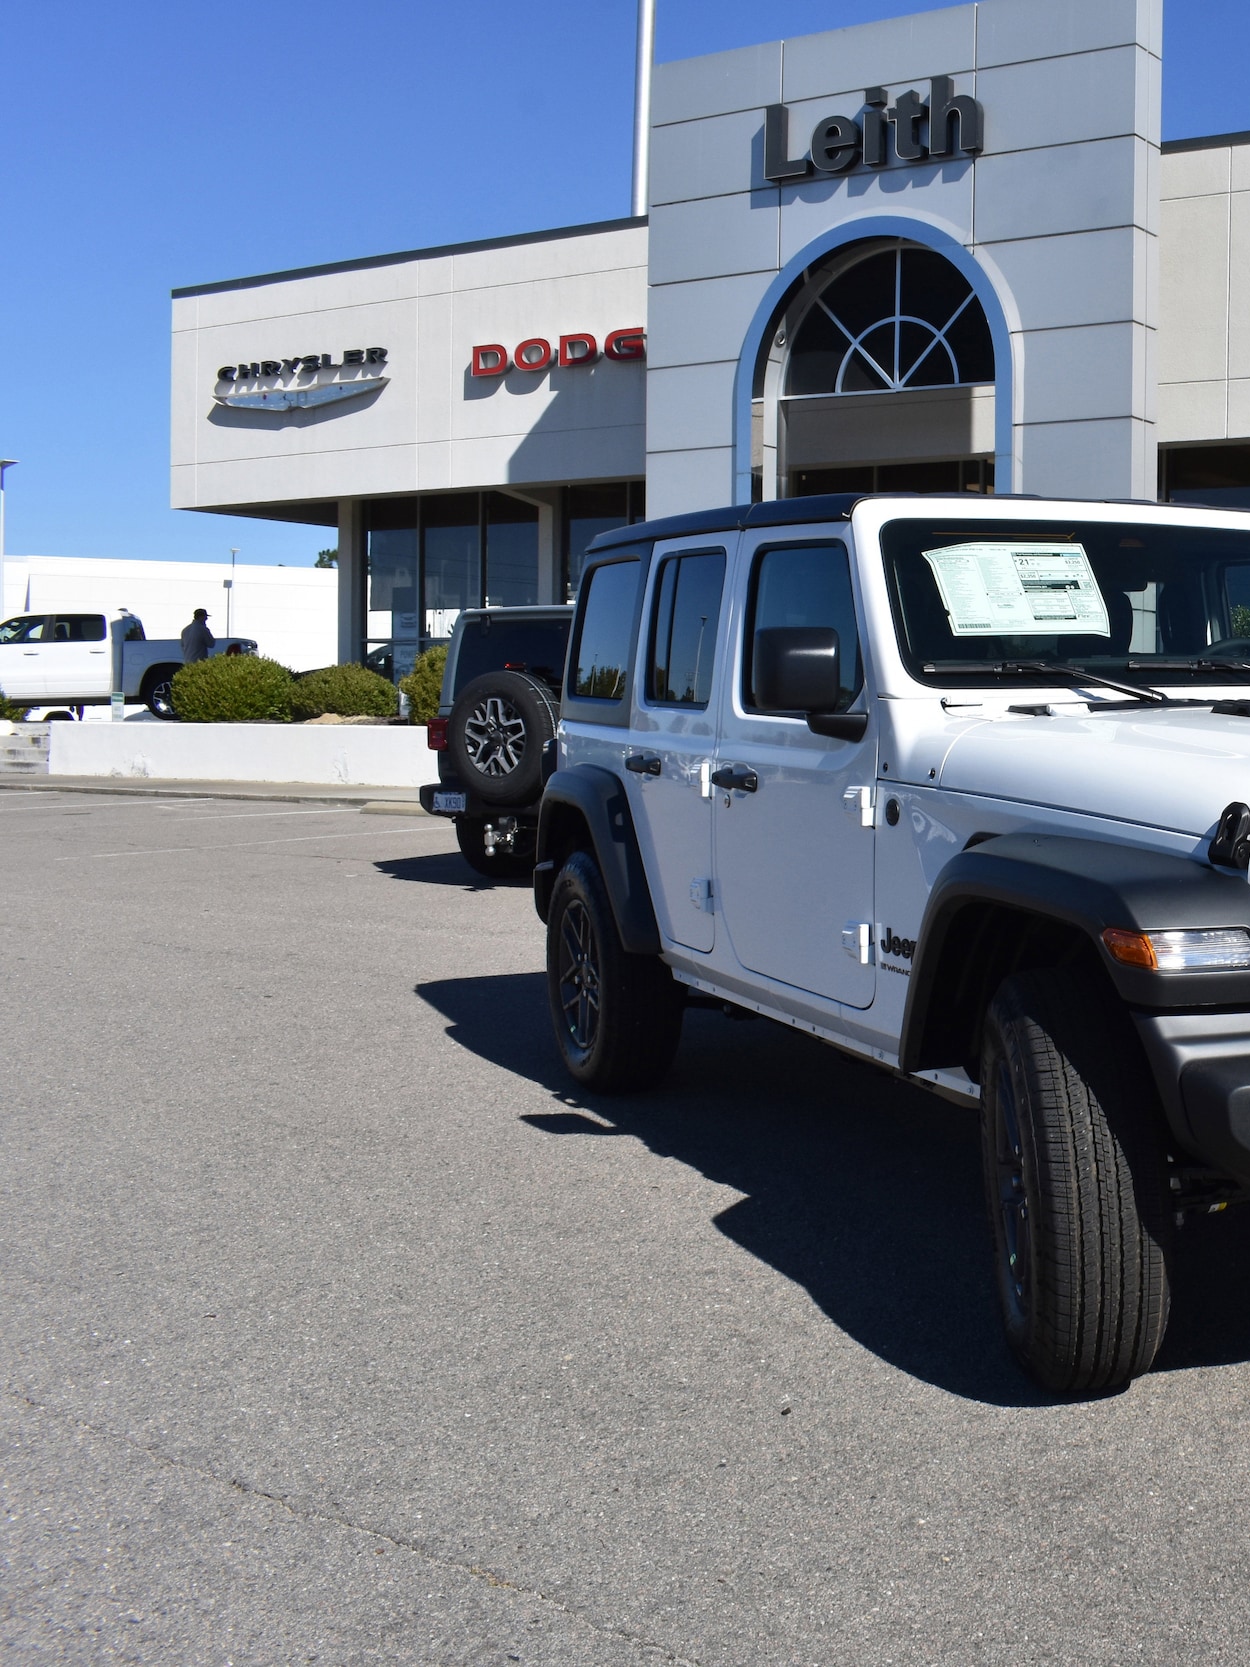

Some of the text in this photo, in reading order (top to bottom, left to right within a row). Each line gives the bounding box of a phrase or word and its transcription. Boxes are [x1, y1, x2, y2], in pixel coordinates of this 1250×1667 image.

[764, 75, 984, 182] Leith
[217, 346, 389, 382] CHRYSLER
[472, 326, 646, 377] DODG
